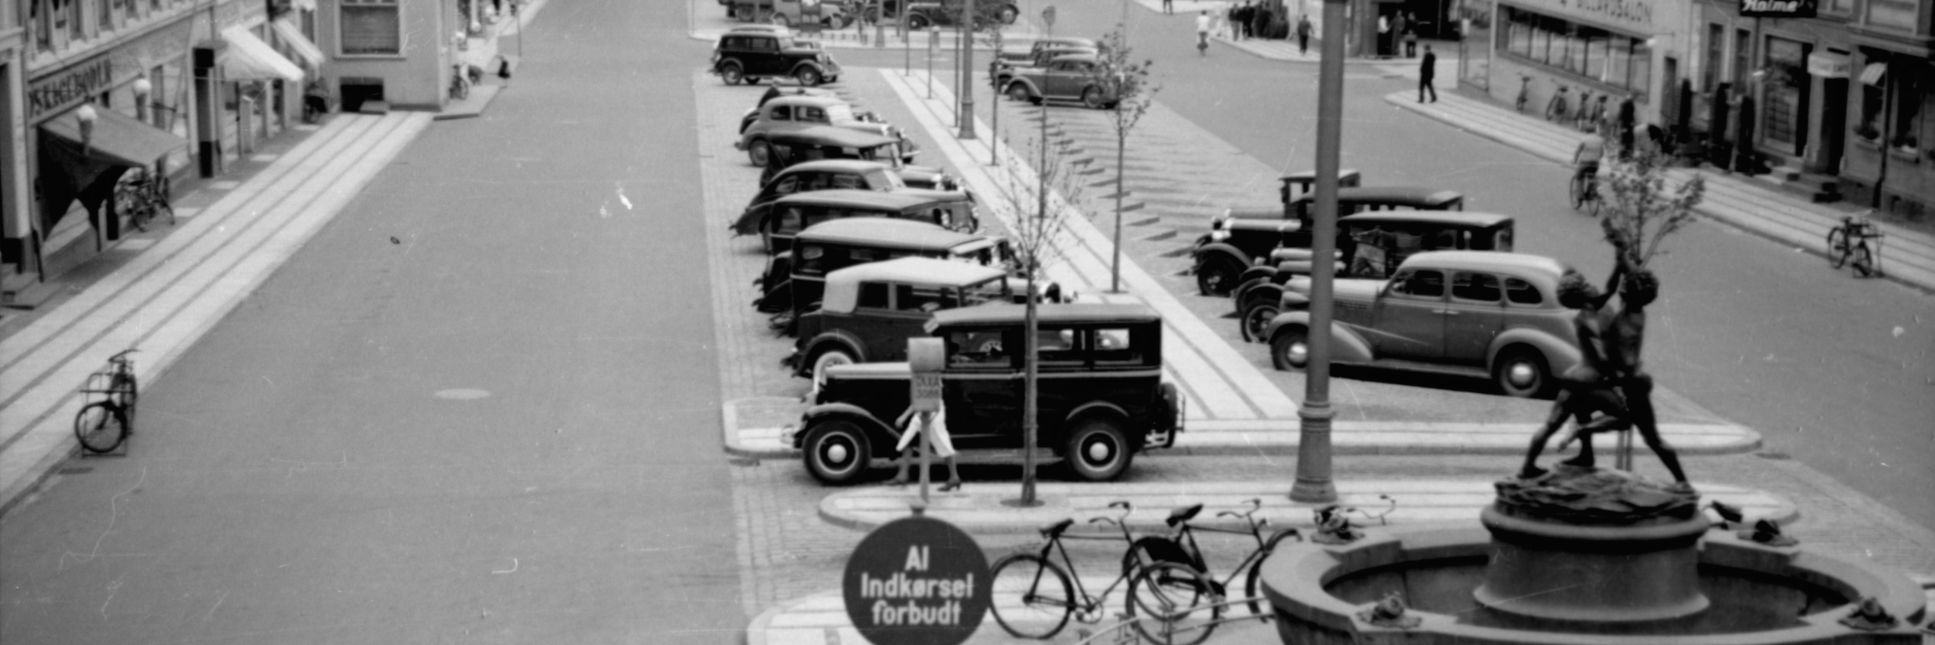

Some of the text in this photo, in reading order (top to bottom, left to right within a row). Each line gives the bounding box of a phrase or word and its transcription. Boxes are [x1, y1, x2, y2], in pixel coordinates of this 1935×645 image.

[905, 545, 930, 571] Al
[861, 572, 974, 598] Indkørsel
[872, 600, 962, 625] forbudt
